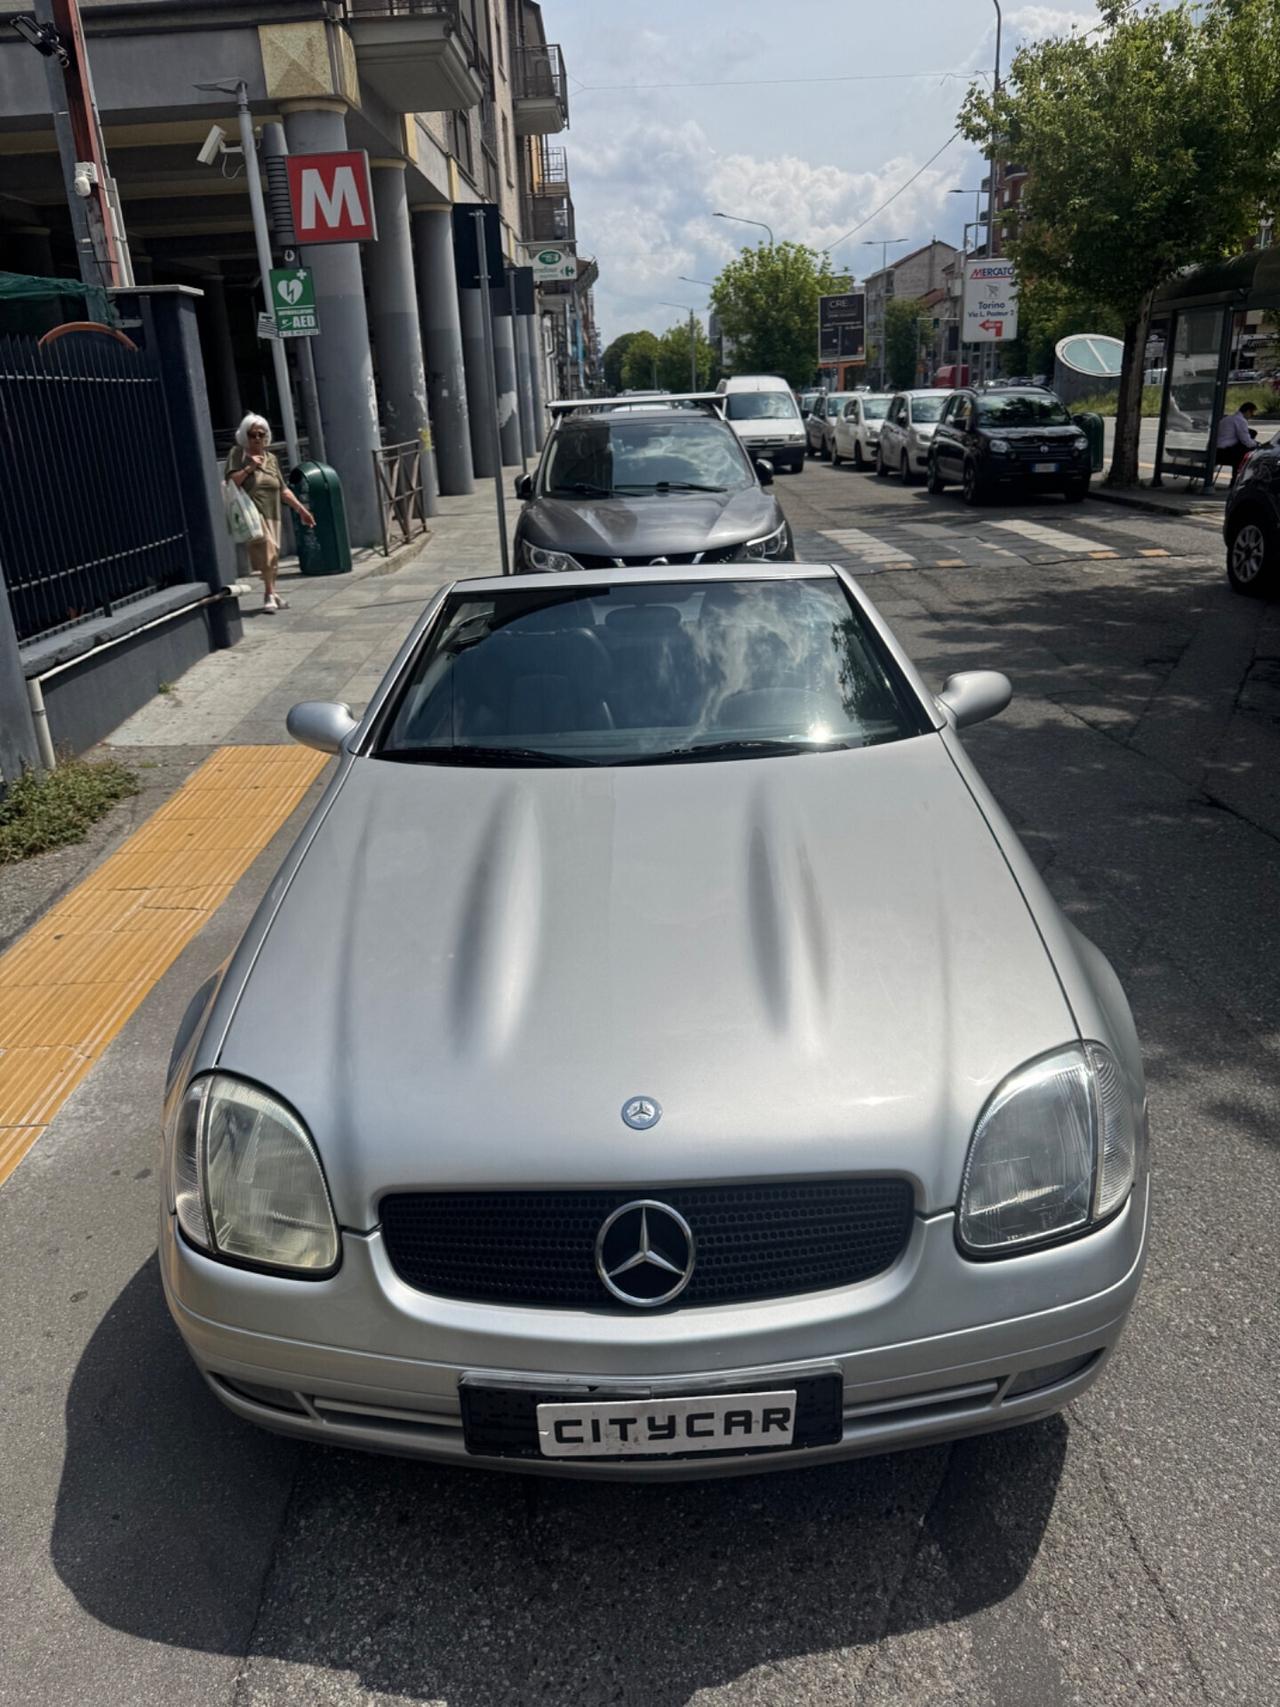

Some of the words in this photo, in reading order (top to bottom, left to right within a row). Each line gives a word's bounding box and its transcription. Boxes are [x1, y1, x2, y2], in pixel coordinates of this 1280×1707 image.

[301, 166, 366, 230] M
[971, 267, 1014, 277] MERCATO
[978, 301, 1005, 309] Torino
[293, 315, 315, 328] AED
[554, 1407, 791, 1443] CITYCAR
